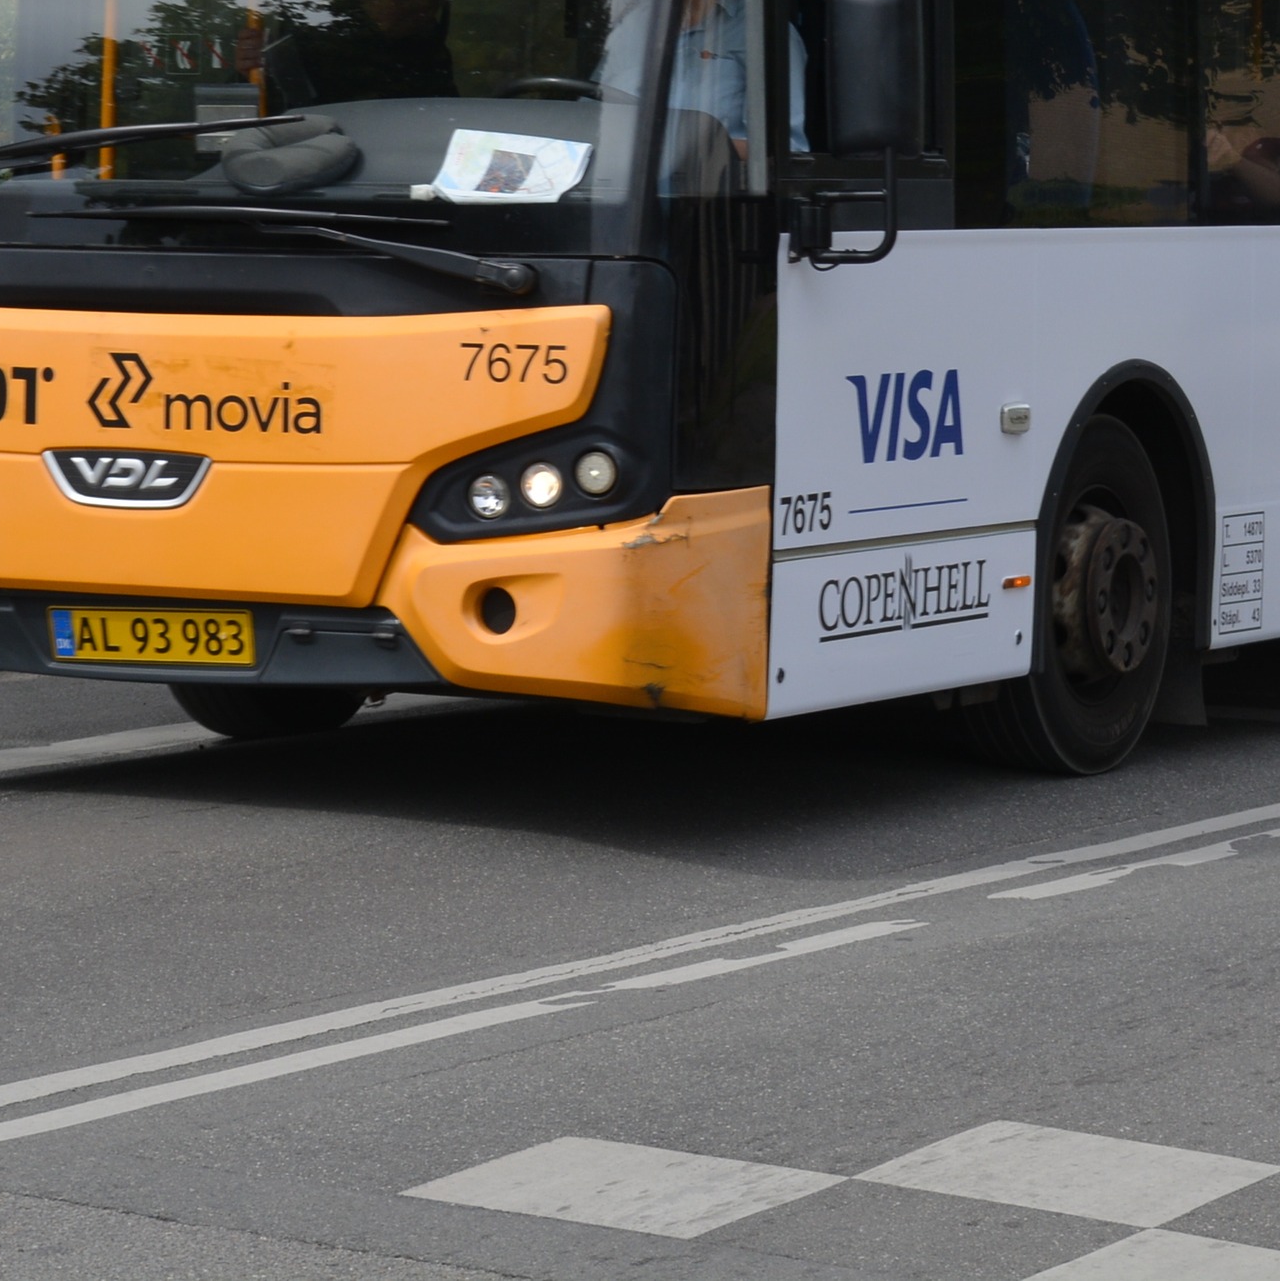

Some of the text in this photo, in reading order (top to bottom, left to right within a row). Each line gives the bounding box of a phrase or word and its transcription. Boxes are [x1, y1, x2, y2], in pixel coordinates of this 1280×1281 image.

[460, 342, 569, 384] 7675
[164, 382, 323, 434] movia
[845, 369, 964, 464] VISA
[70, 457, 180, 490] VDL
[780, 491, 832, 536] 7675
[819, 555, 991, 631] COPENHELL
[77, 616, 120, 651] AL
[131, 617, 171, 654] 93
[182, 618, 244, 656] 983
